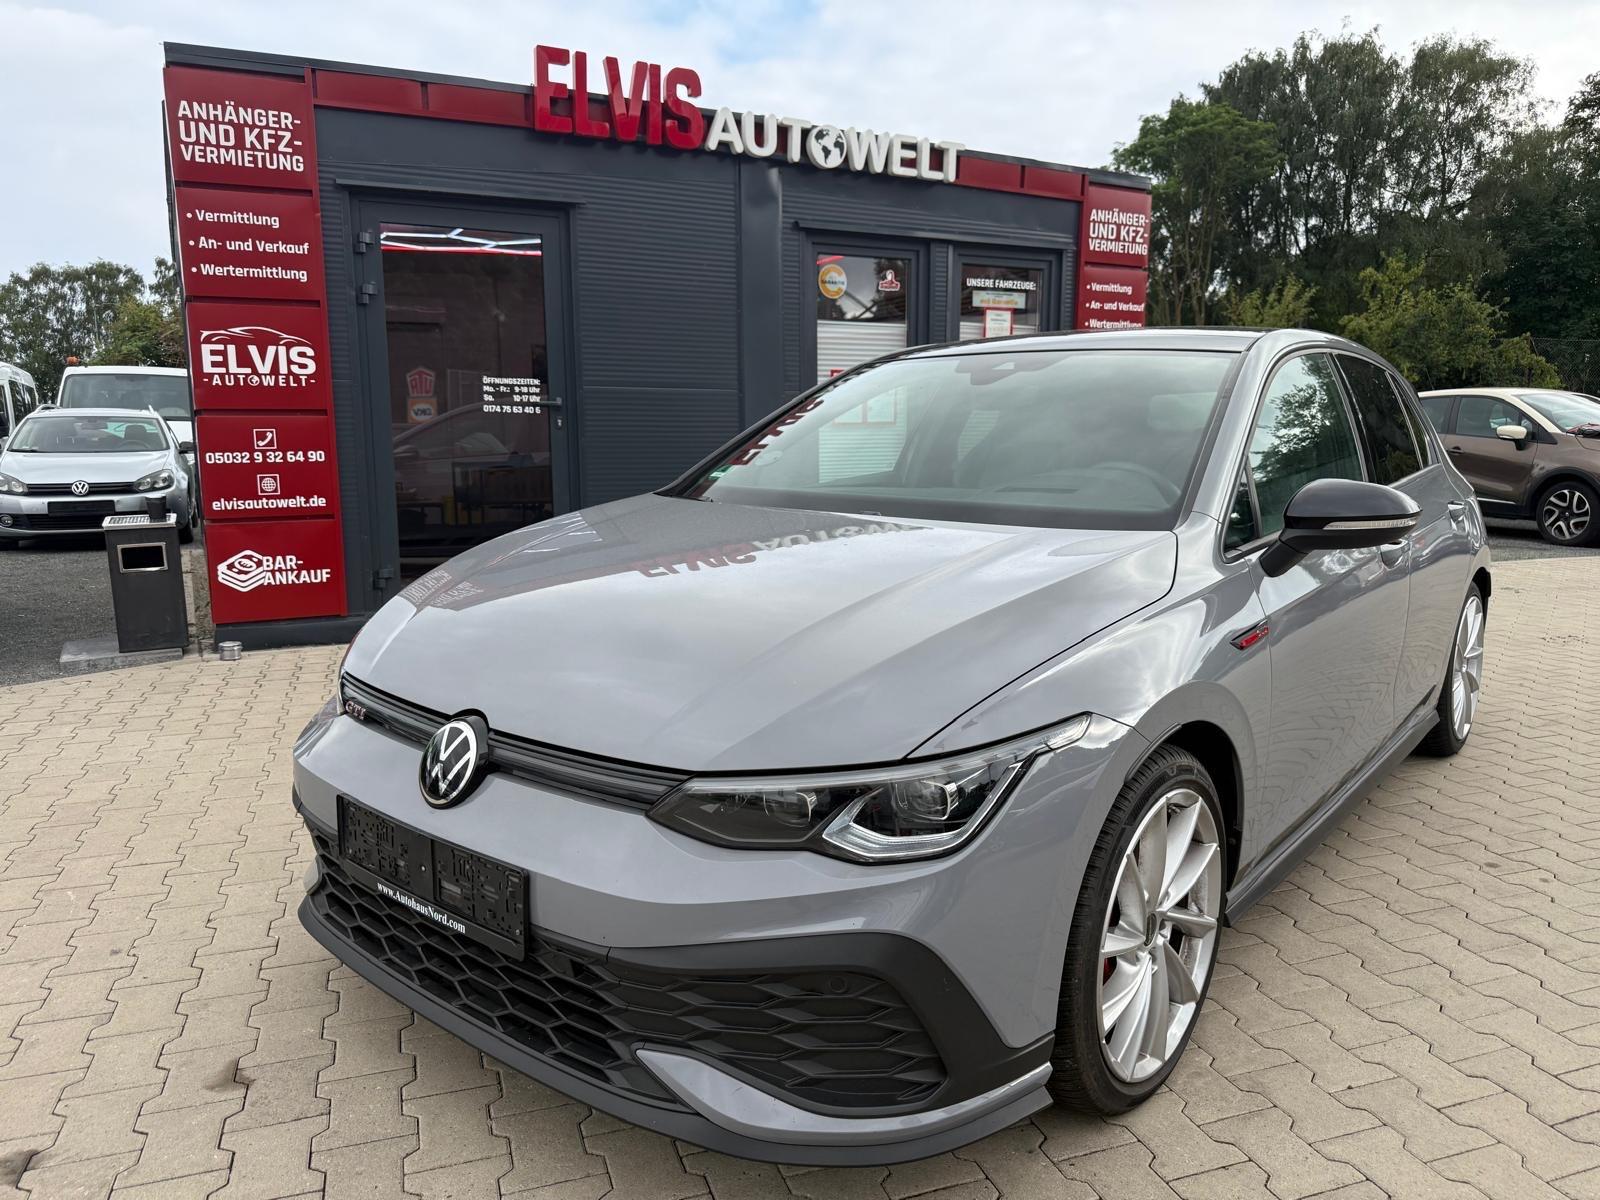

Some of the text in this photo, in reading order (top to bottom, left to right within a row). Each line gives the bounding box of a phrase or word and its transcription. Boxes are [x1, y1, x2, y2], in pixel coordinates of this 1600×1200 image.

[178, 100, 301, 130] ANHÄNGER-
[533, 44, 966, 183] ELVIS AUTOWELT
[179, 120, 302, 153] UND KFZ-
[180, 144, 304, 172] VERMIETUNG
[195, 209, 280, 228] Vermittlung
[1090, 208, 1149, 227] ANHÄNGER-
[1090, 223, 1148, 243] UND KFZ-
[199, 236, 309, 255] An- und Verkauf
[1089, 238, 1148, 256] VERMIETUNG
[200, 264, 307, 282] Wertermittlung
[967, 278, 1036, 290] UNSERE FAHRZEUGE:
[1091, 282, 1132, 295] Vermittlung
[1090, 300, 1145, 311] An- und Verkauf
[201, 344, 316, 375] ELVIS
[483, 375, 540, 385] ÖFFNUNGSZEITEN:
[483, 404, 501, 412] 0174
[524, 406, 534, 414] 40
[205, 450, 325, 464] 05032 9 32 64 90
[212, 495, 327, 510] elvisautowelt.de
[262, 555, 303, 571] BAR-
[264, 569, 331, 585] ANKAUF
[345, 700, 366, 720] GTI
[377, 882, 466, 934] www.AutohausNord.com
